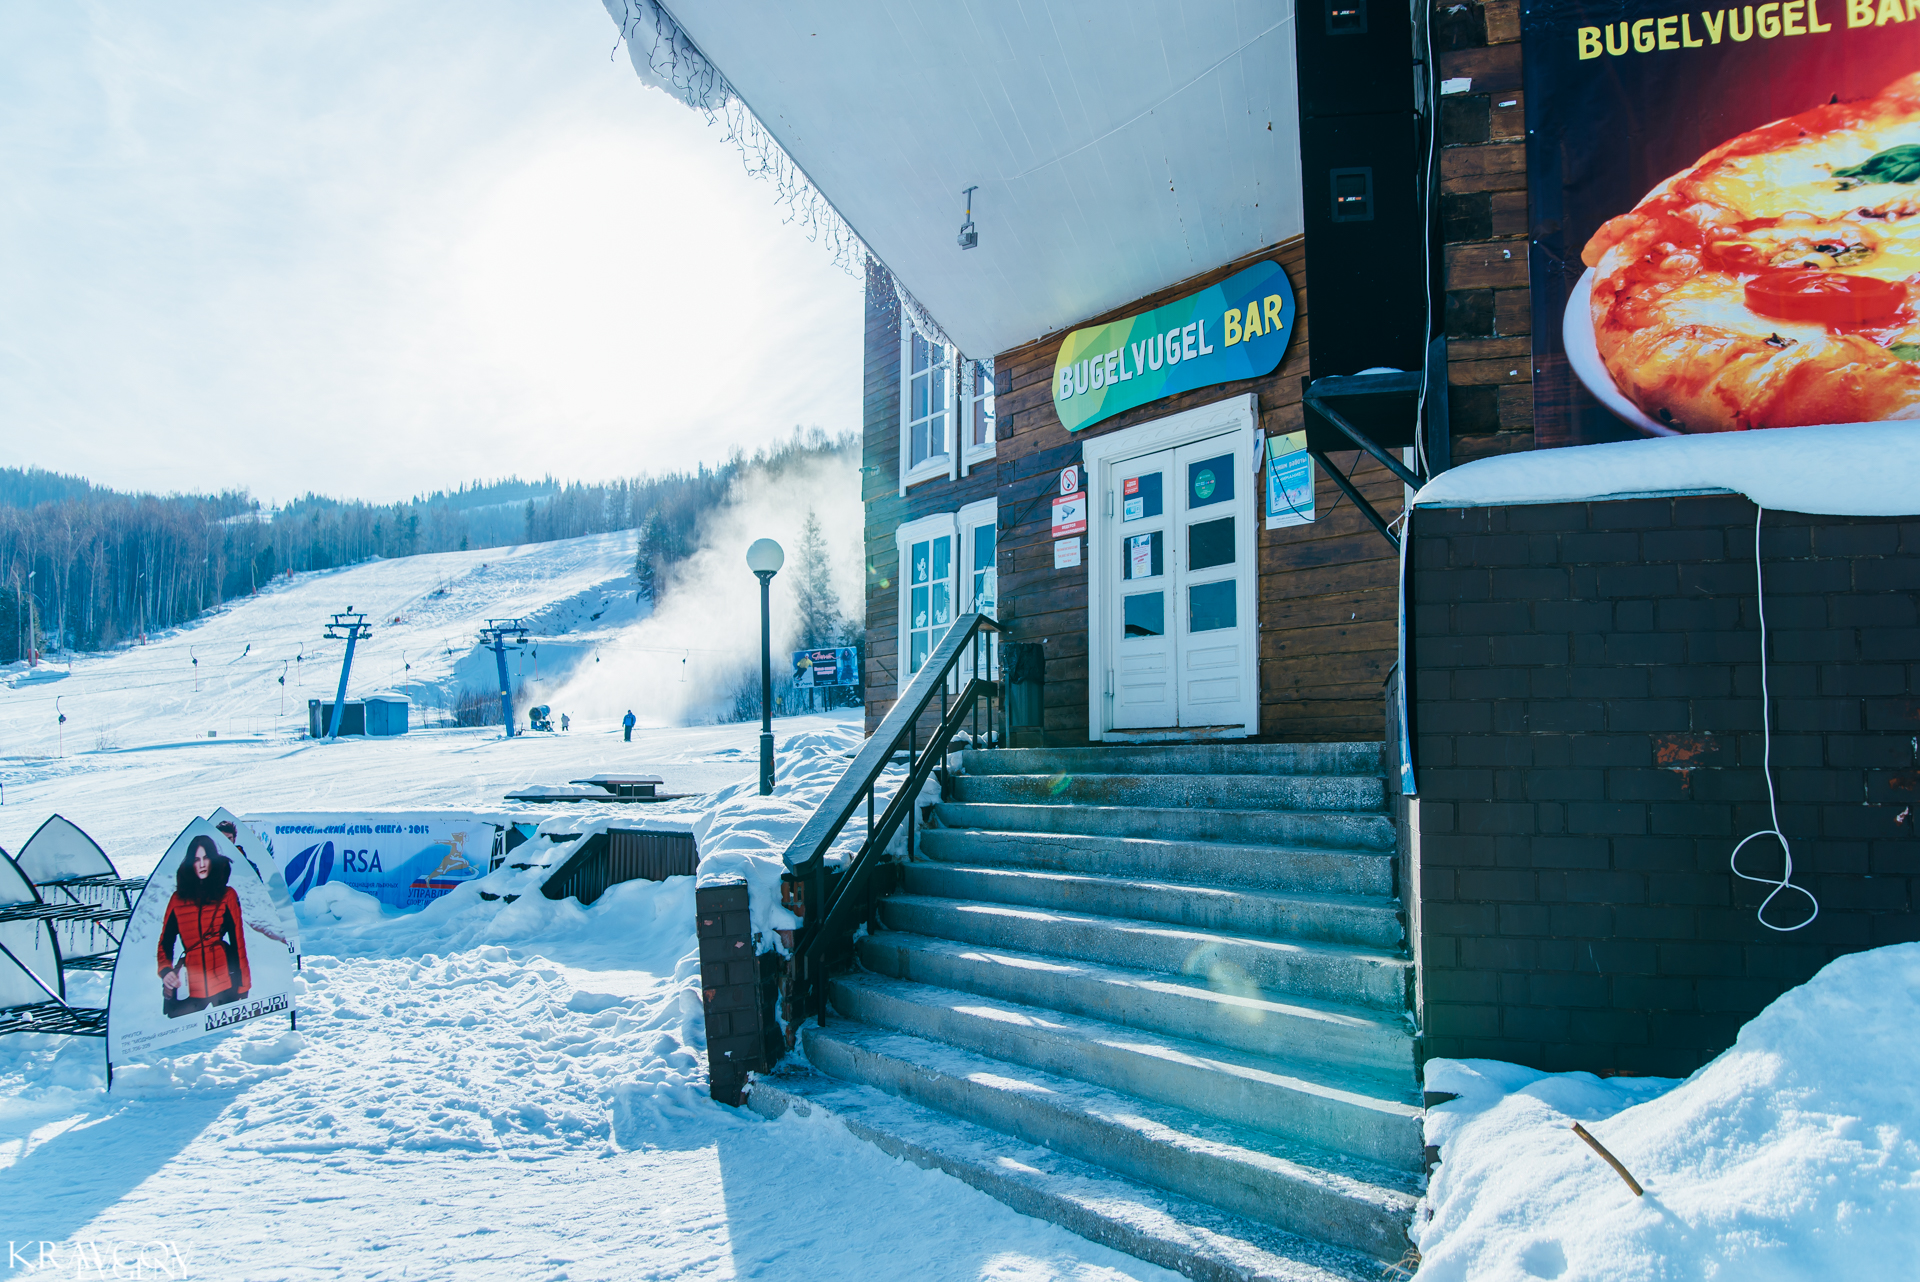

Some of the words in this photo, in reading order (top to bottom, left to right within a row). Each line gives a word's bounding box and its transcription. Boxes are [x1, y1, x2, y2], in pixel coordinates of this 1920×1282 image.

[1577, 0, 1832, 60] BUGELVUGEL
[1058, 319, 1214, 401] BUGELVUGEL
[1224, 294, 1284, 348] BAR
[346, 825, 372, 835] ДЕНЬ
[375, 824, 402, 834] СНЕГА
[409, 824, 429, 834] 2015
[343, 849, 383, 873] RSA
[408, 888, 453, 898] УПРАВЛЕ
[205, 992, 288, 1032] NAPAPIJRI
